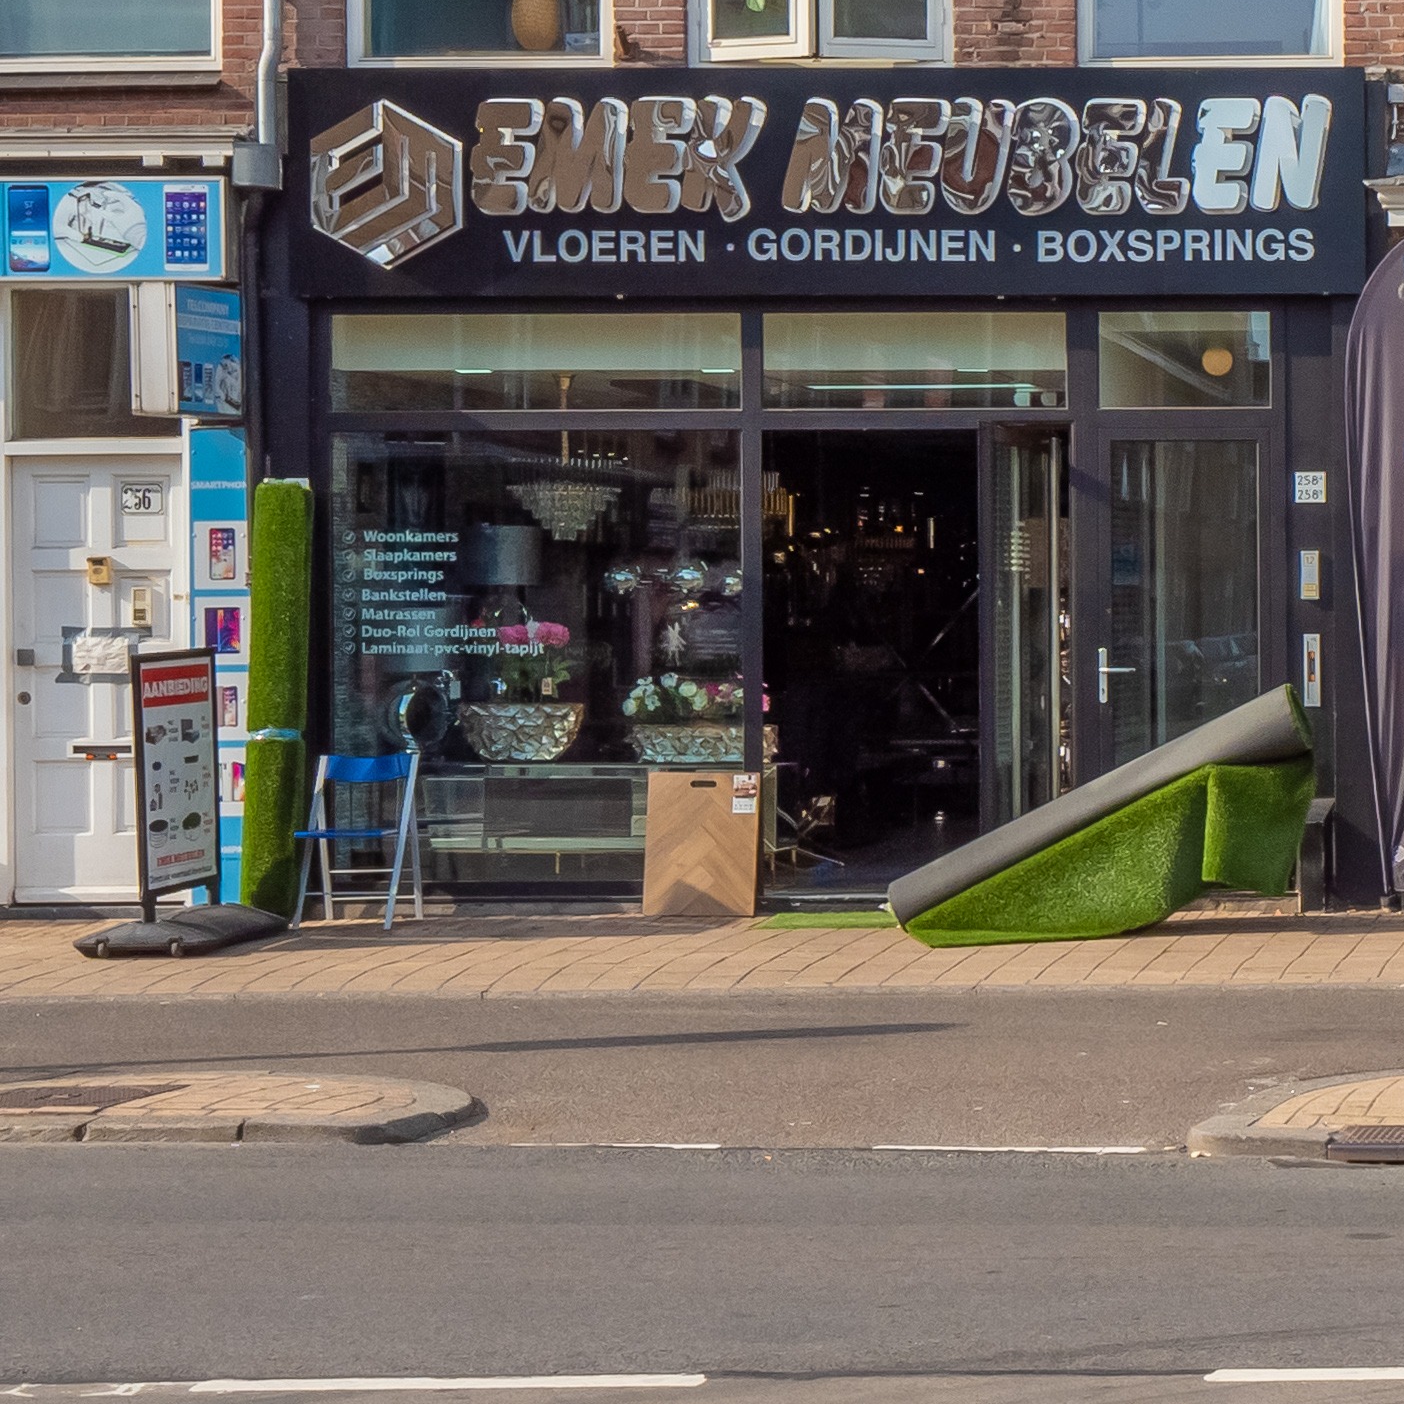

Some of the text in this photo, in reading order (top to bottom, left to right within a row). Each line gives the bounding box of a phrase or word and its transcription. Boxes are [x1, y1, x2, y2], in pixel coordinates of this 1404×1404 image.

[471, 94, 1332, 222] EMEK MEUBELEN
[502, 227, 1315, 263] VLOEREN GORDIJNEN BOXSPRINGS
[123, 487, 151, 510] 256
[363, 530, 459, 543] Woonkamers
[363, 549, 457, 564] Slaapkamers
[363, 568, 444, 583] Boxsprings
[362, 589, 447, 601] Bankstellen
[361, 608, 436, 620] Matrassen
[361, 625, 497, 640] Duo-Rol Gordijnen
[361, 642, 545, 656] Laminaat-pvc-vinyl-tapijt
